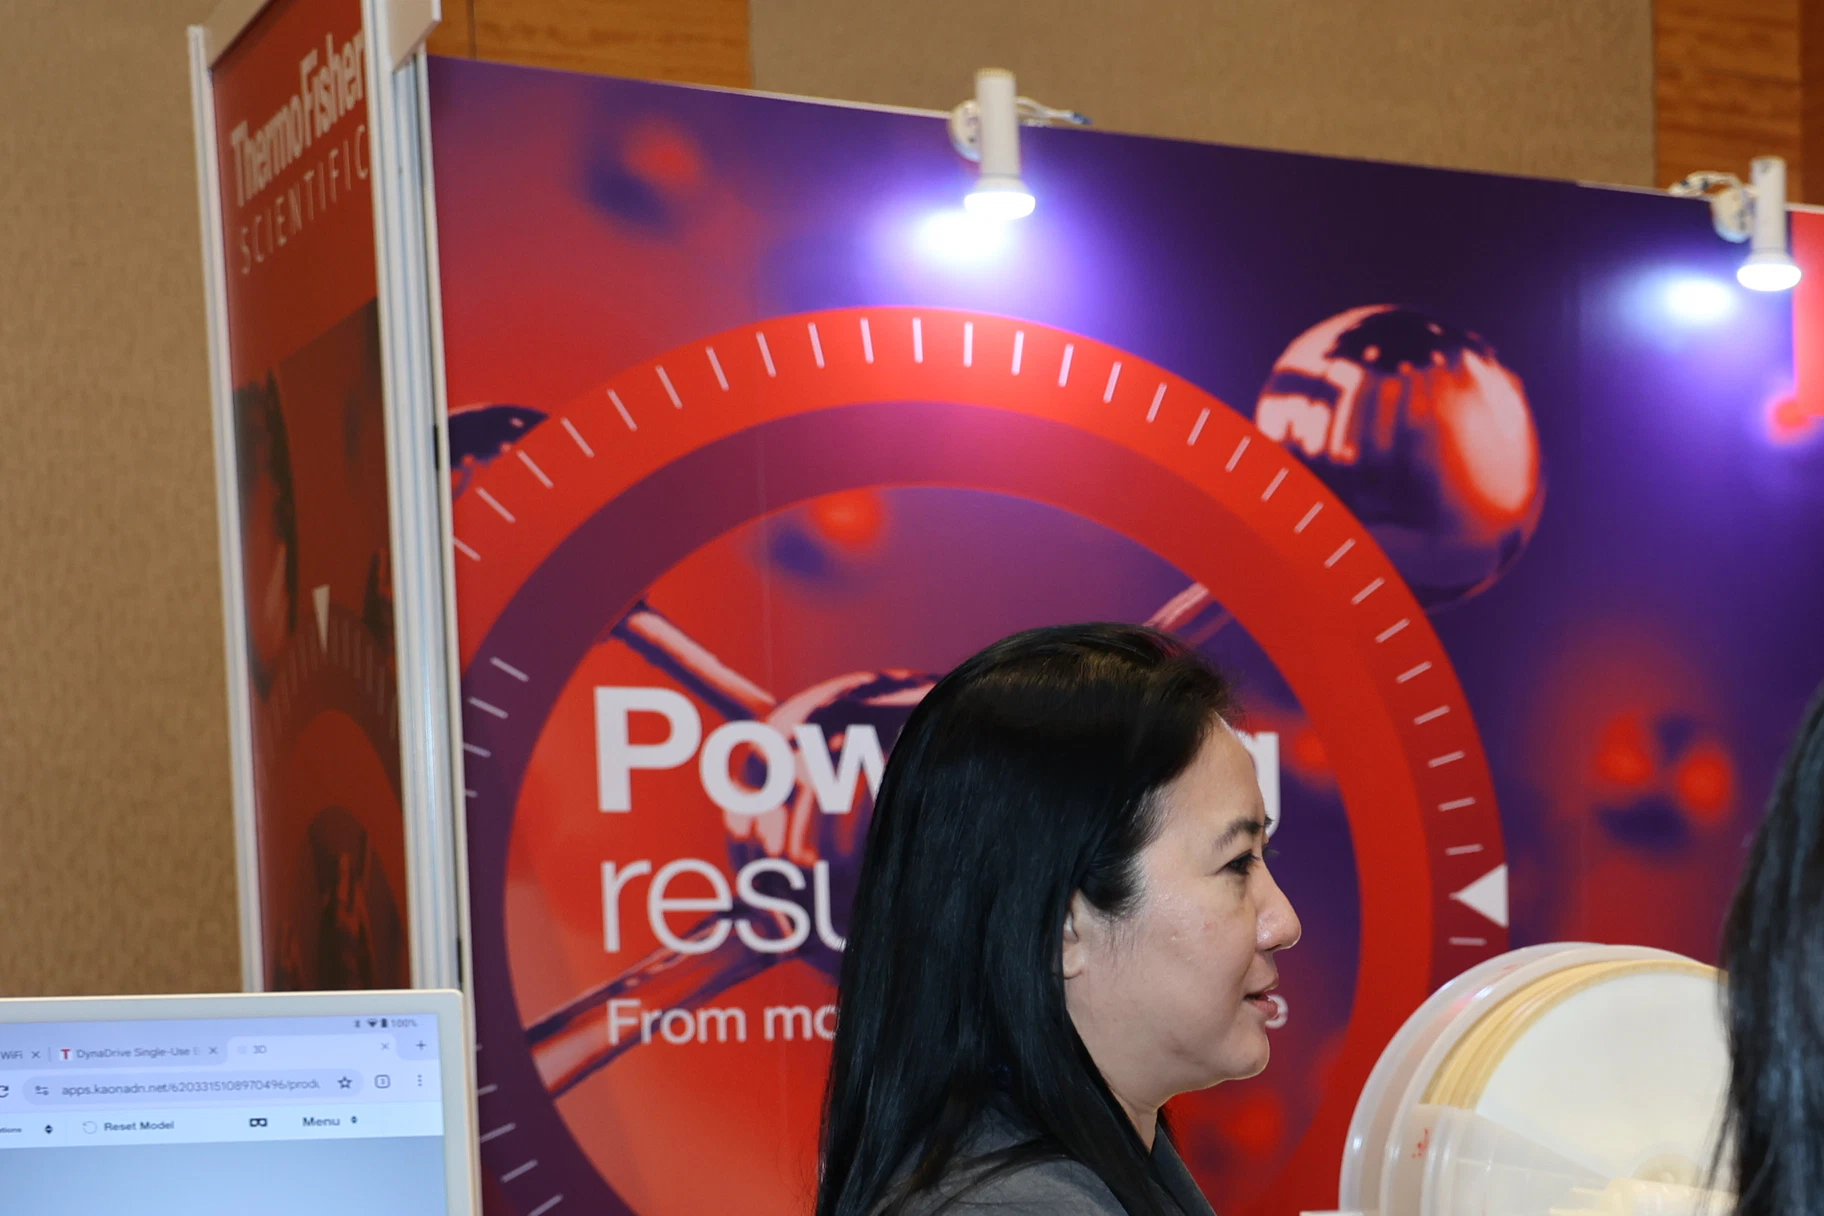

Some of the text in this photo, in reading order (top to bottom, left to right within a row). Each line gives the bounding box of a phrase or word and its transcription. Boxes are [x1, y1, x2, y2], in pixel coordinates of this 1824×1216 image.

[240, 125, 369, 274] SCIENTIFIC
[606, 998, 747, 1046] From
[763, 1004, 841, 1042] mo
[76, 1047, 132, 1060] DynaDrive
[133, 1046, 190, 1059] Single-Use
[104, 1120, 175, 1131] Reset Model
[302, 1117, 341, 1127] Menu
